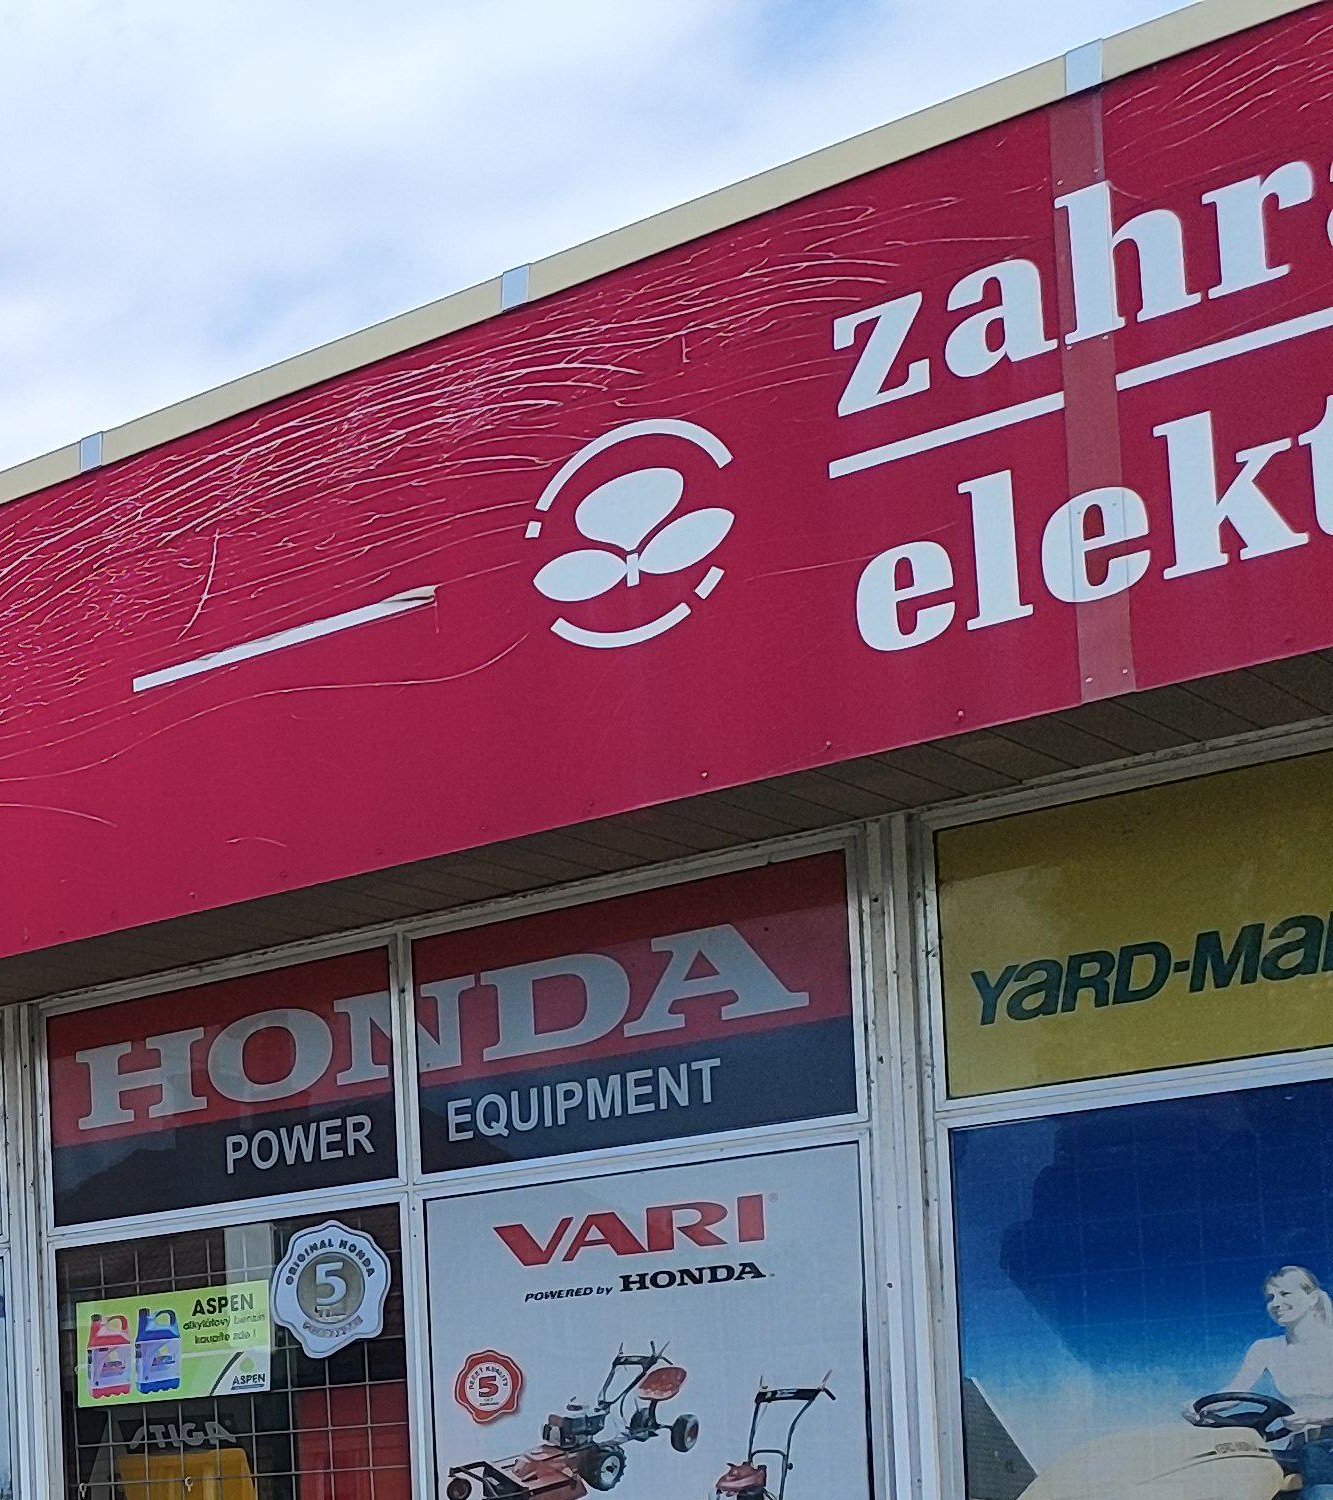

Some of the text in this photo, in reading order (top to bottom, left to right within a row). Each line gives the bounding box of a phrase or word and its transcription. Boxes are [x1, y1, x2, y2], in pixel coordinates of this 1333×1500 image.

[833, 160, 1333, 417] zahr
[75, 923, 810, 1131] HONDA
[225, 1057, 722, 1175] POWER EQUIPMENT
[493, 1193, 765, 1267] VARI
[285, 1238, 376, 1286] ORIGINAL HONDA
[315, 1261, 347, 1306] 5
[524, 1261, 767, 1303] POWERED by HONDA
[191, 1292, 255, 1317] ASPEN
[232, 1372, 266, 1386] ASPEN
[478, 1375, 499, 1398] 5
[128, 1420, 238, 1450] STIGA
